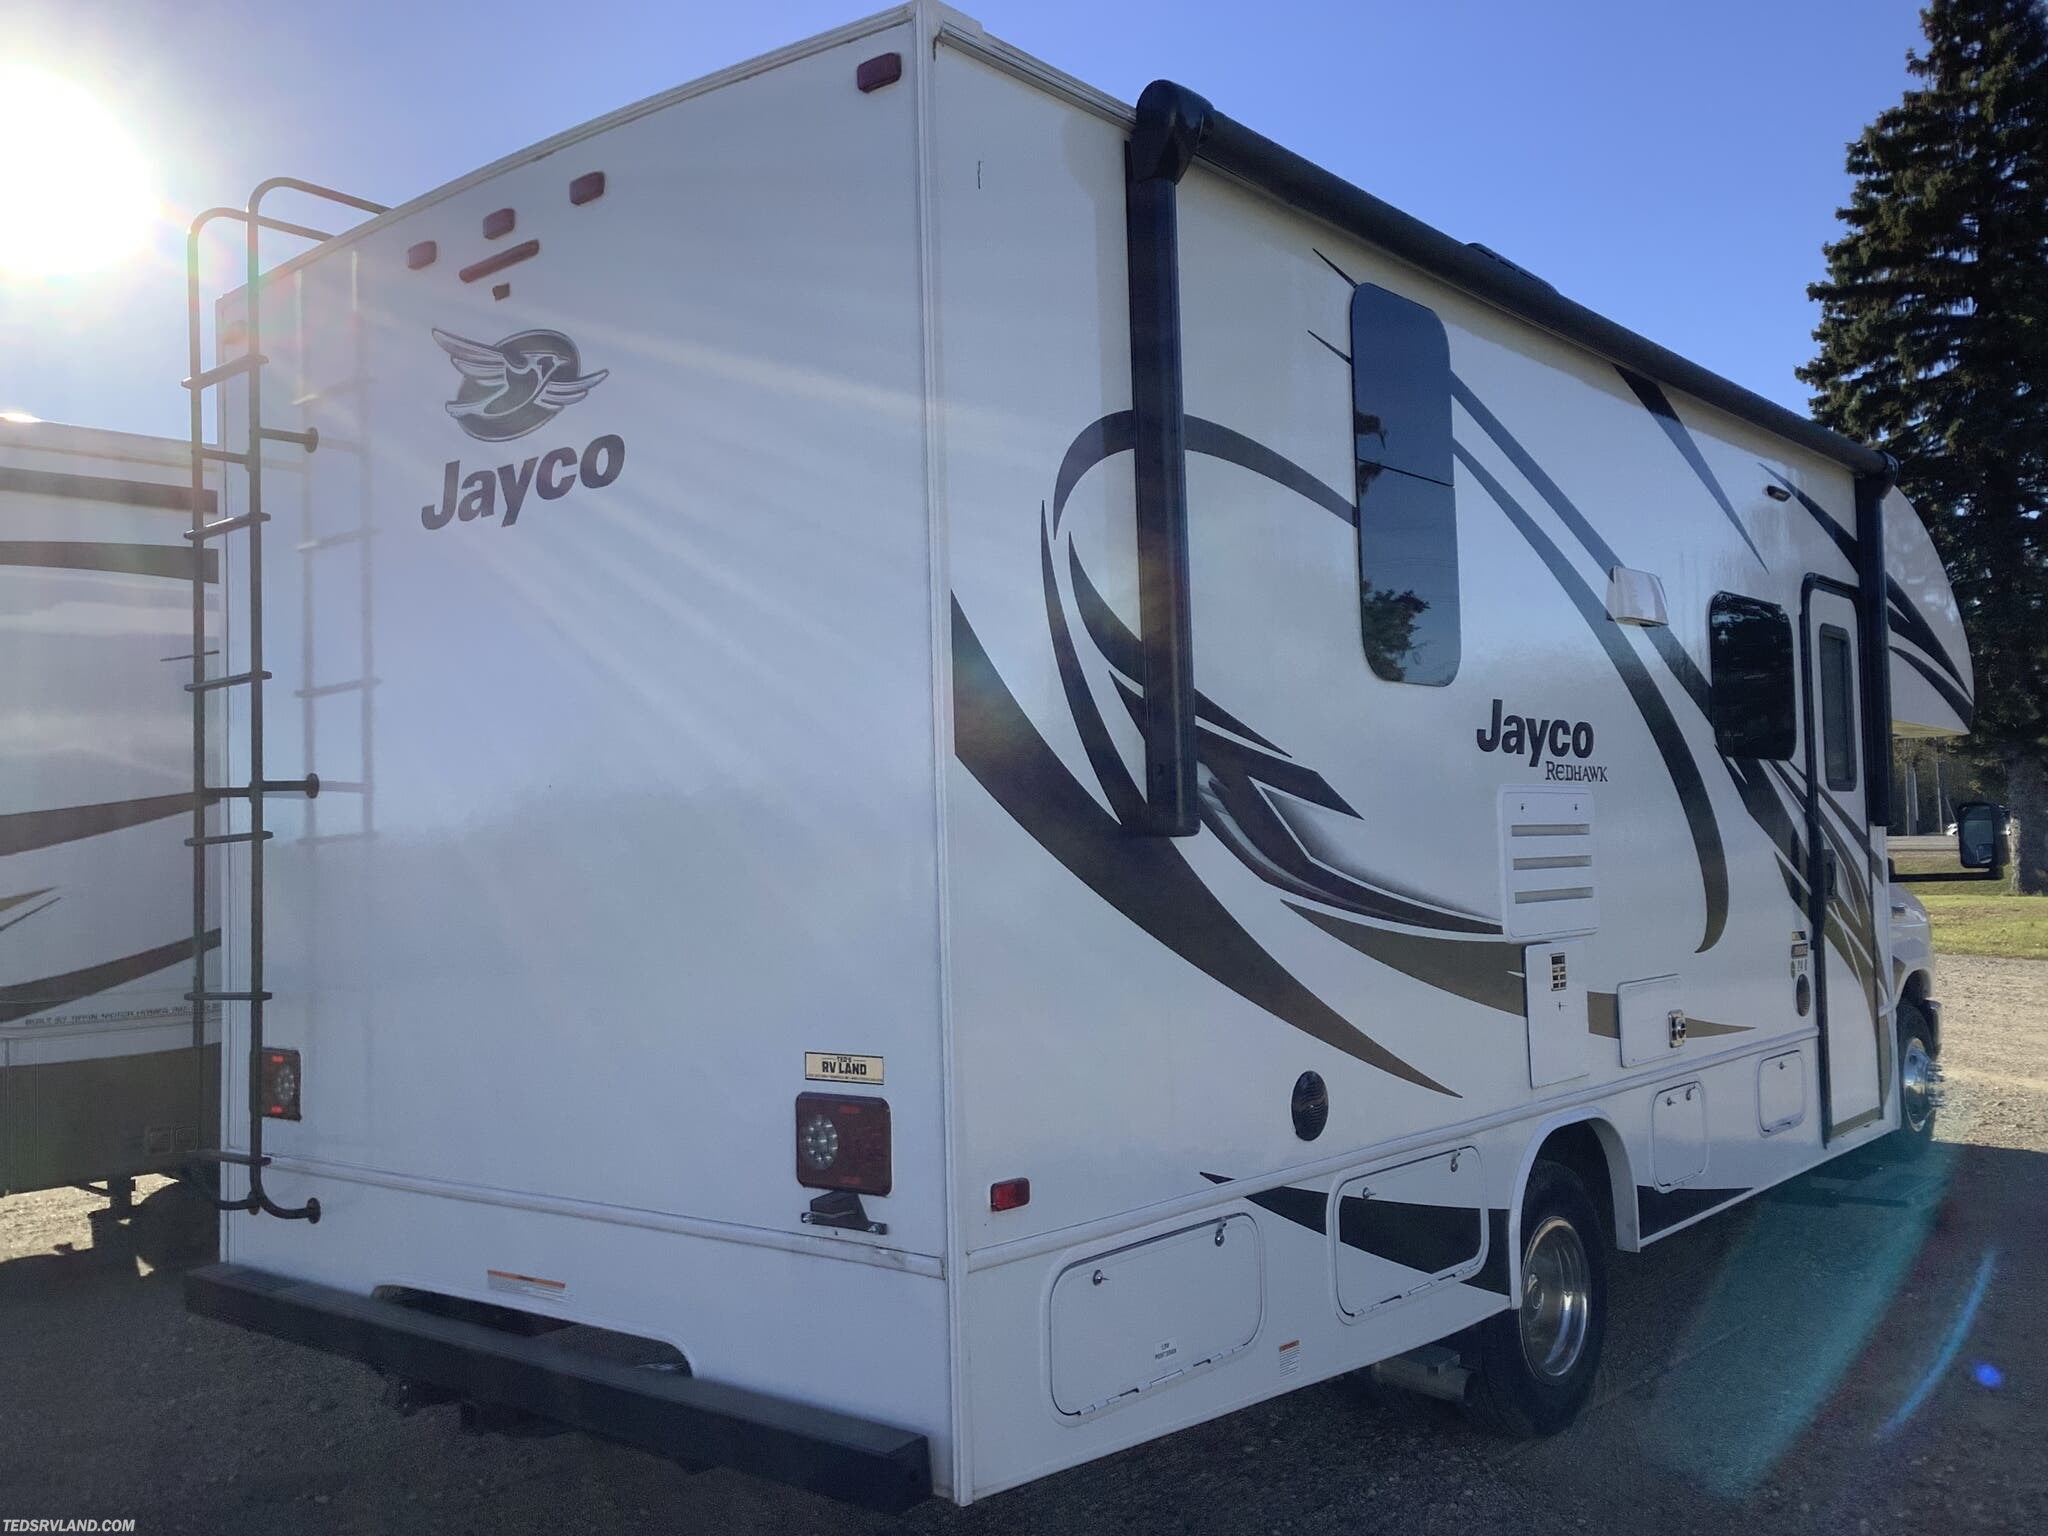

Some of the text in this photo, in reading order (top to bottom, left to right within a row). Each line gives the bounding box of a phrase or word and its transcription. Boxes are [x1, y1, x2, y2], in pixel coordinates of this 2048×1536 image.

[421, 434, 626, 530] Jayco
[1476, 698, 1594, 768] Jayco
[822, 1061, 867, 1075] RV LAND
